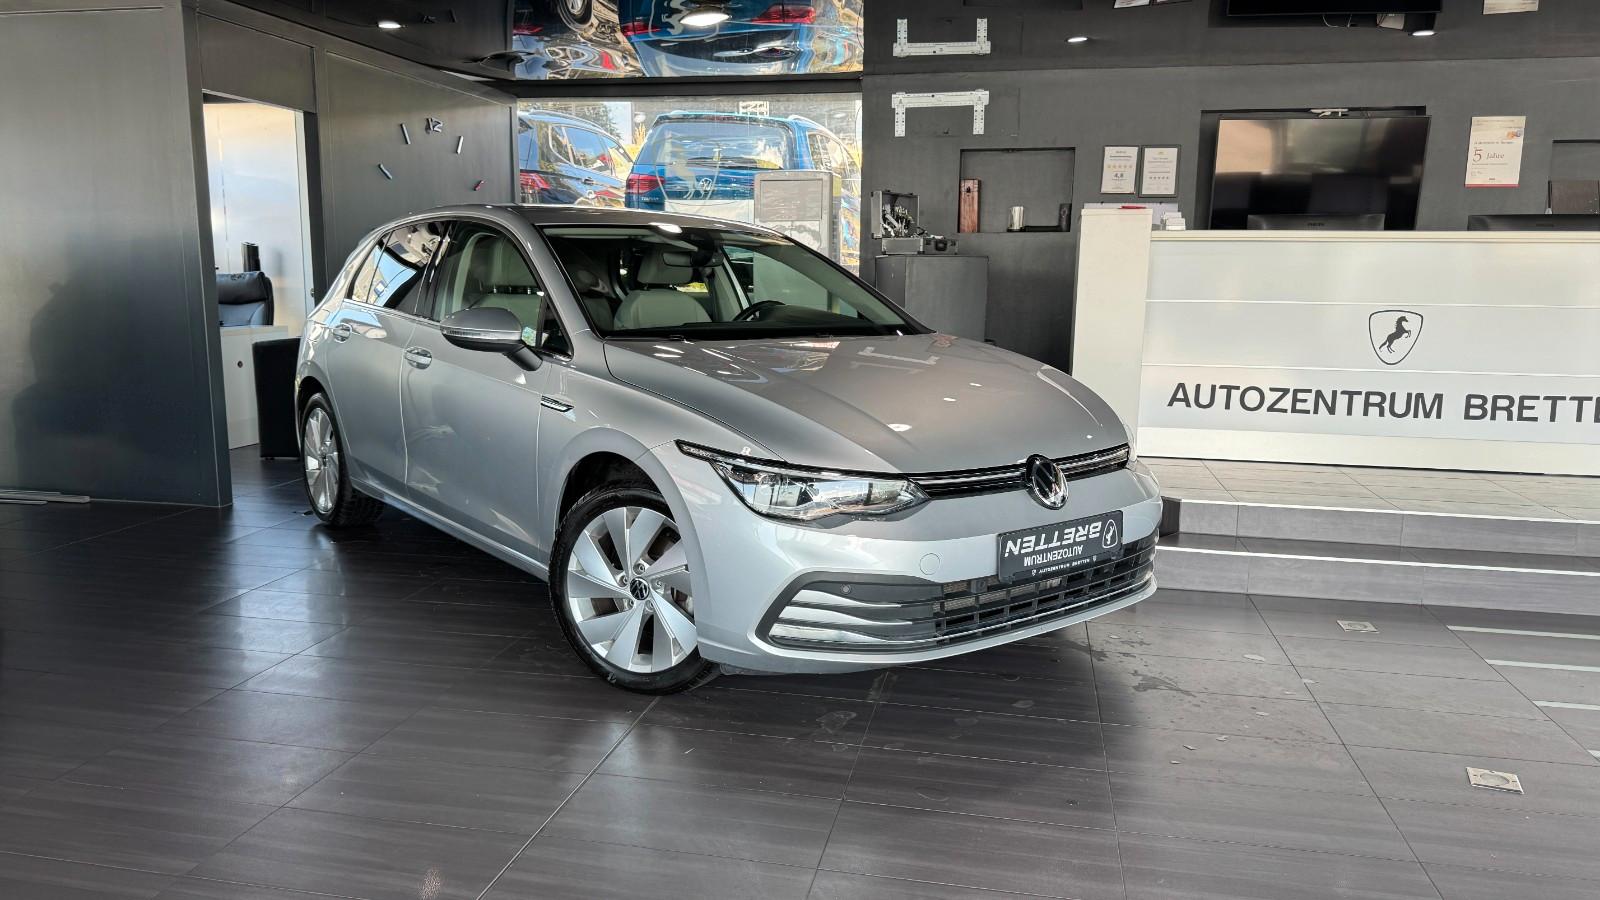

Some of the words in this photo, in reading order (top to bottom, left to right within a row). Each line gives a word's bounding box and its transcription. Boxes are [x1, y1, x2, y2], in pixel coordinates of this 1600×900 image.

[1473, 149, 1483, 162] 5
[1167, 382, 1444, 419] AUTOZENTRUM
[1004, 521, 1103, 558] BRETTEN
[1023, 544, 1084, 567] AUTOZENTRUM
